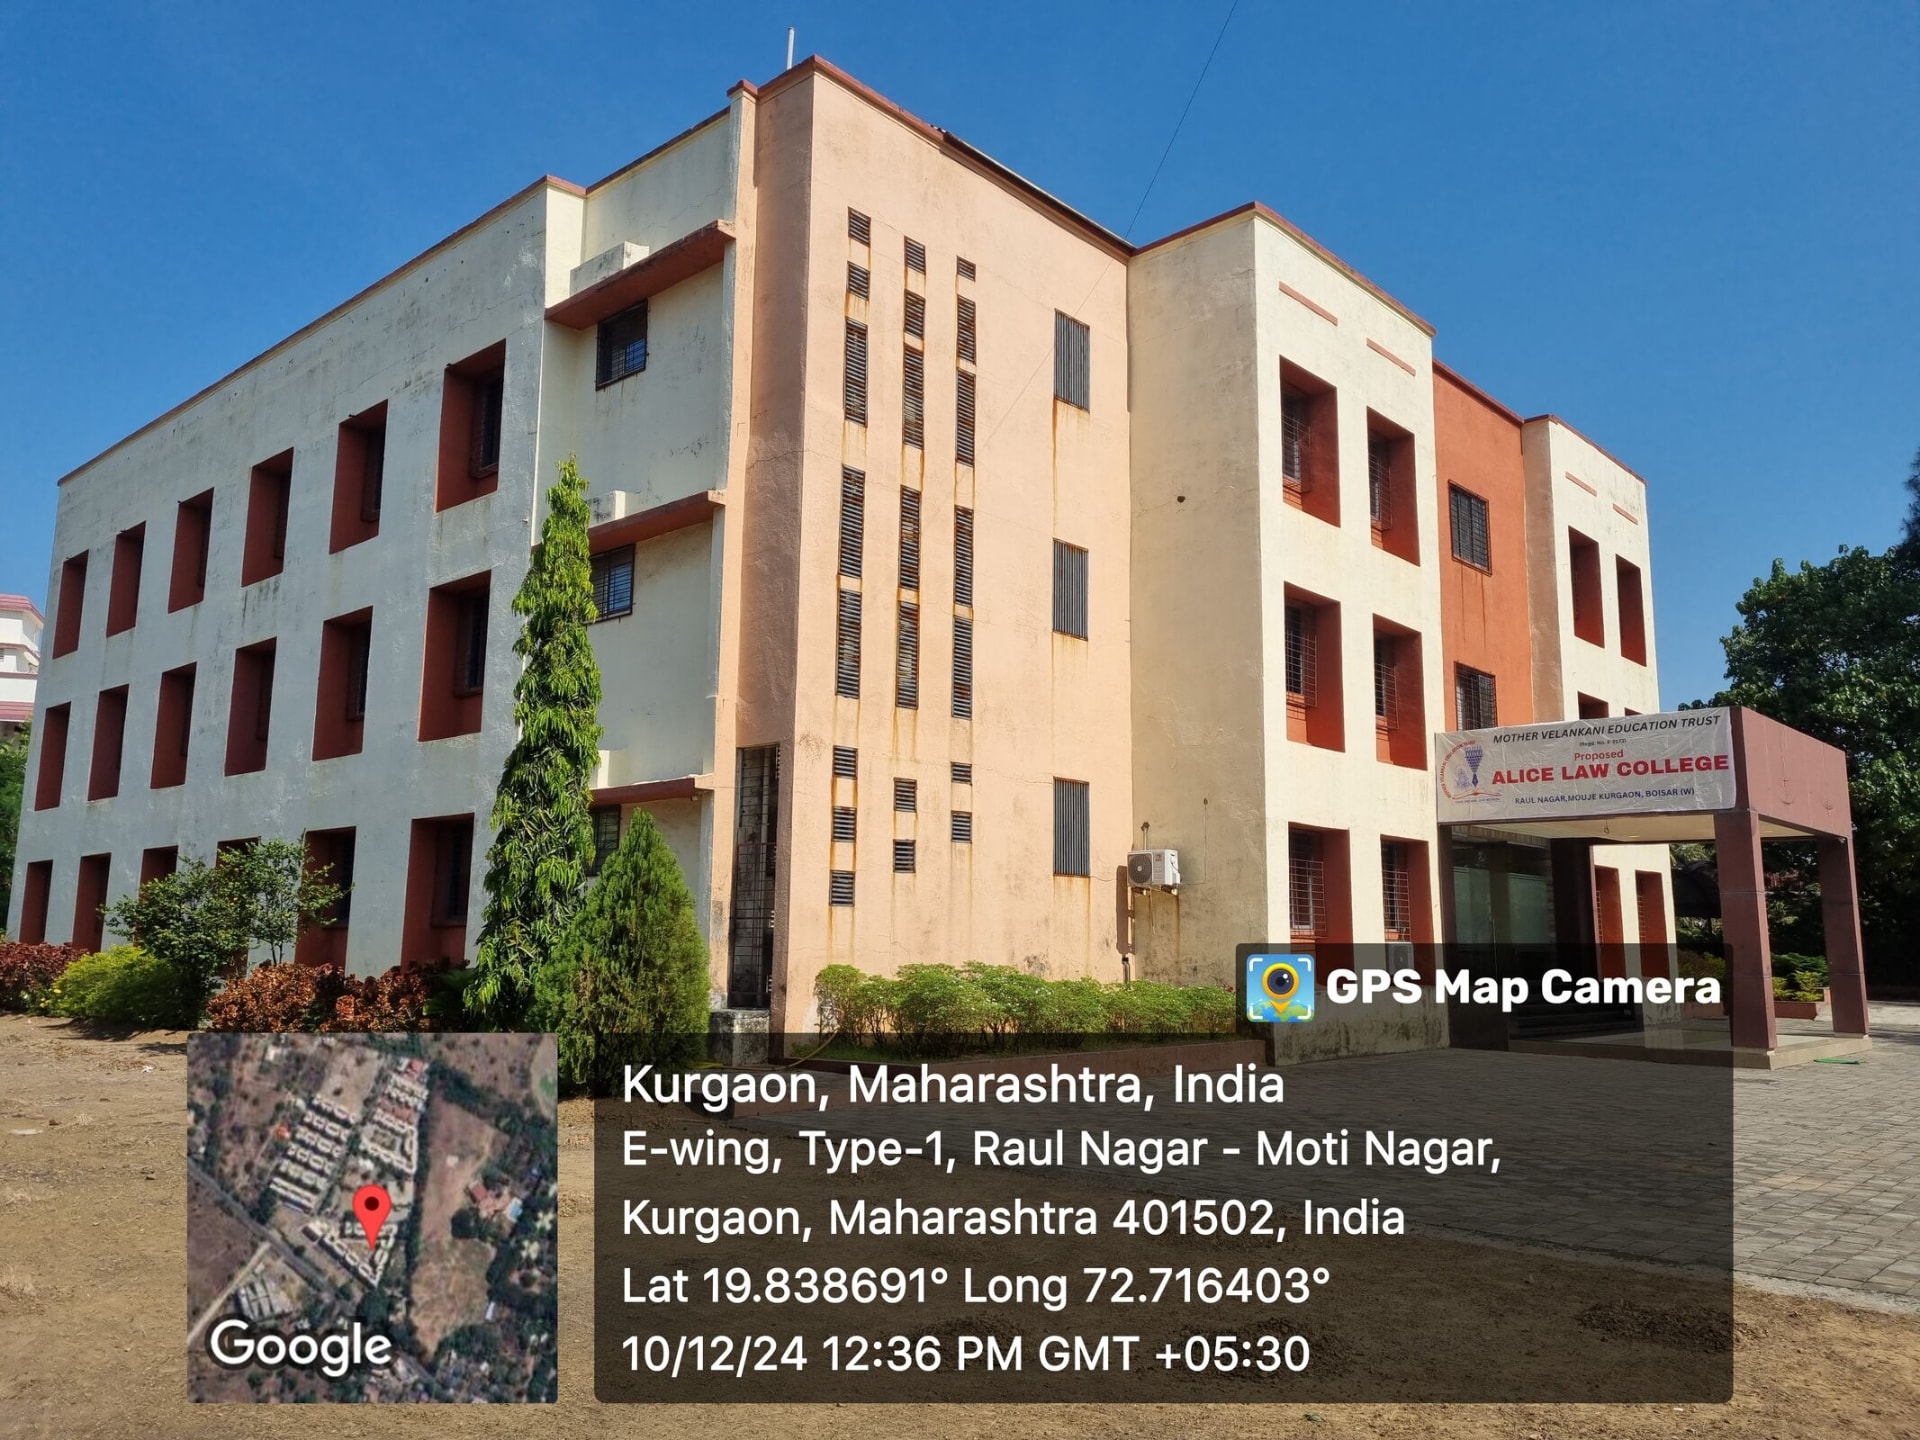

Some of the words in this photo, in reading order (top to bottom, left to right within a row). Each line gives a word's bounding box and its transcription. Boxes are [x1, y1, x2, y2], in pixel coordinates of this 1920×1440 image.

[1493, 731, 1538, 744] MOTHER
[1541, 726, 1605, 740] VELANKANI
[1607, 719, 1678, 735] EDUCATION
[1681, 715, 1721, 728] TRUST
[1574, 749, 1624, 762] Proposed
[1491, 767, 1555, 785] ALICE
[1561, 763, 1610, 781] LAW
[1616, 754, 1729, 777] COLLEGE
[1514, 797, 1536, 805] RAUL
[1645, 788, 1679, 798] BOISAR
[1680, 787, 1695, 796] (W)
